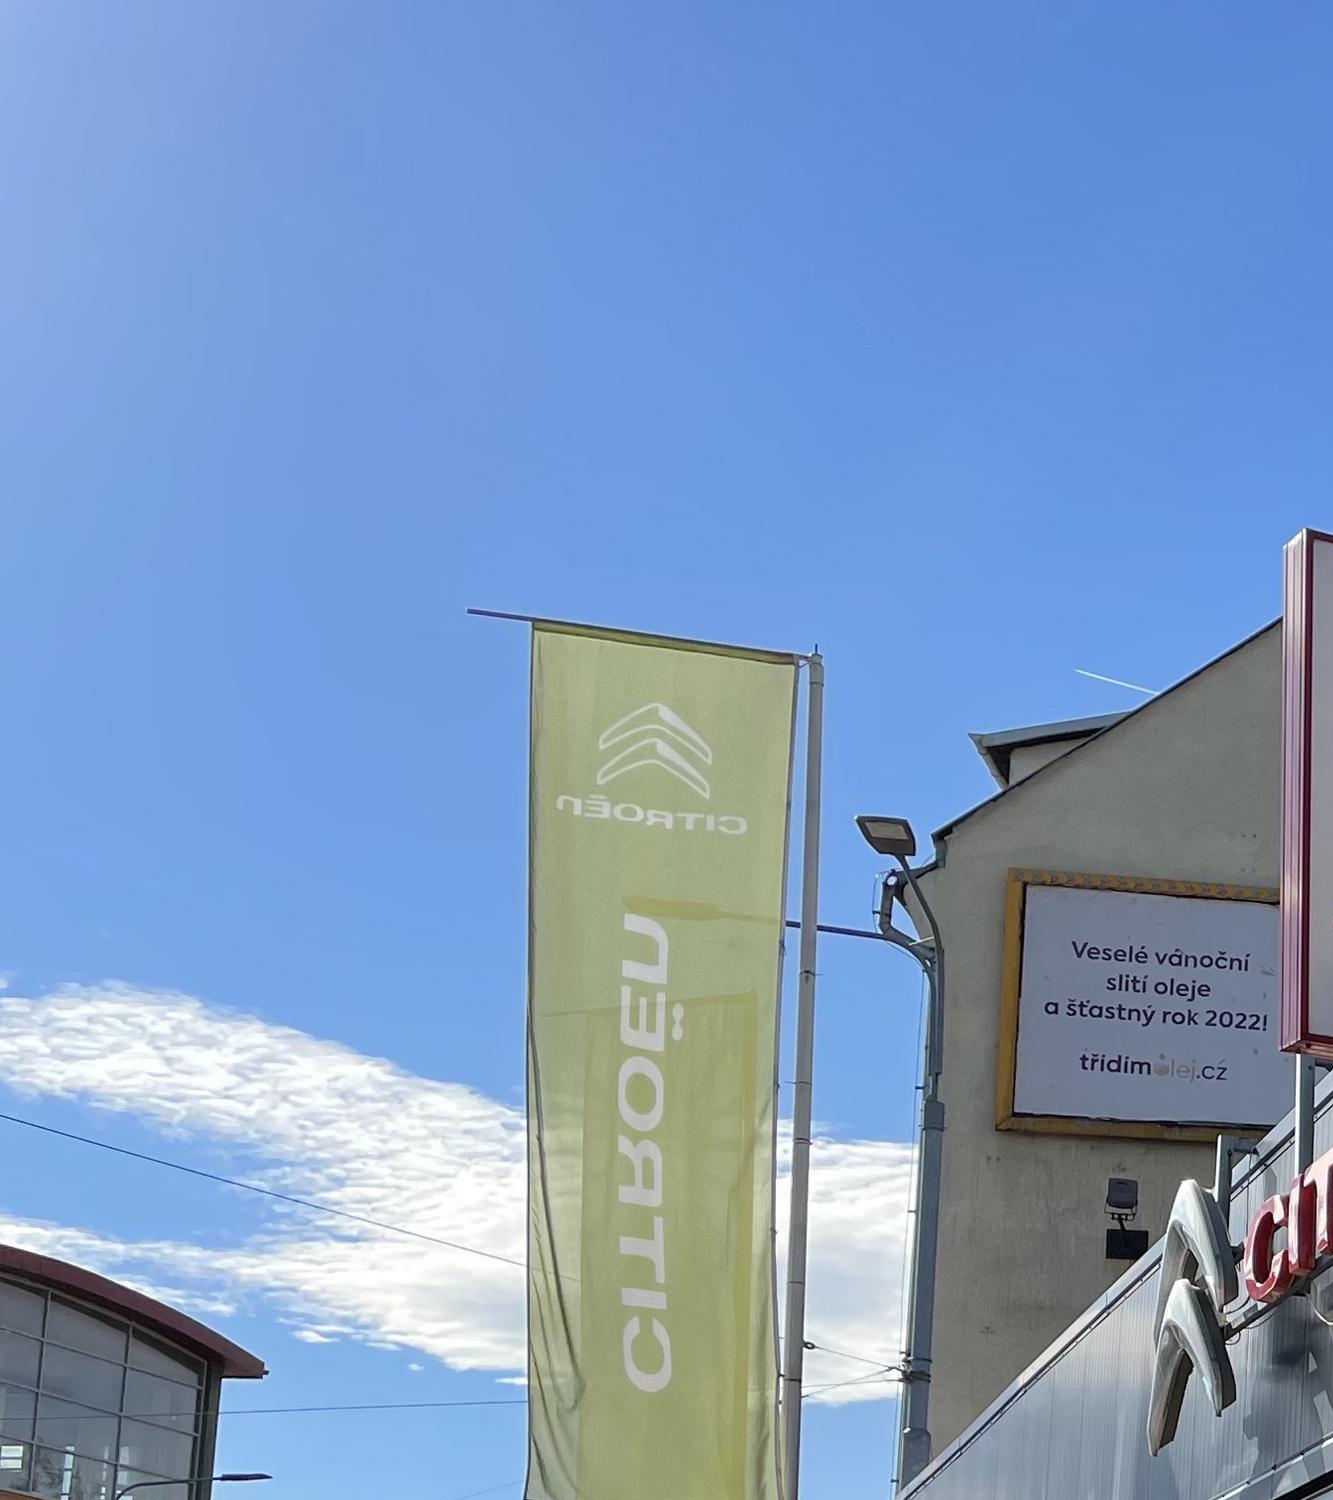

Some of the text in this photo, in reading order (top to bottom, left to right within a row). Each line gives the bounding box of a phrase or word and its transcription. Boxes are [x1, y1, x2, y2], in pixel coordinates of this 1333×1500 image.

[1071, 940, 1251, 973] Veselé vánoční
[1105, 974, 1211, 1001] slití oleje
[1043, 998, 1268, 1032] a šťastný rok 2022!
